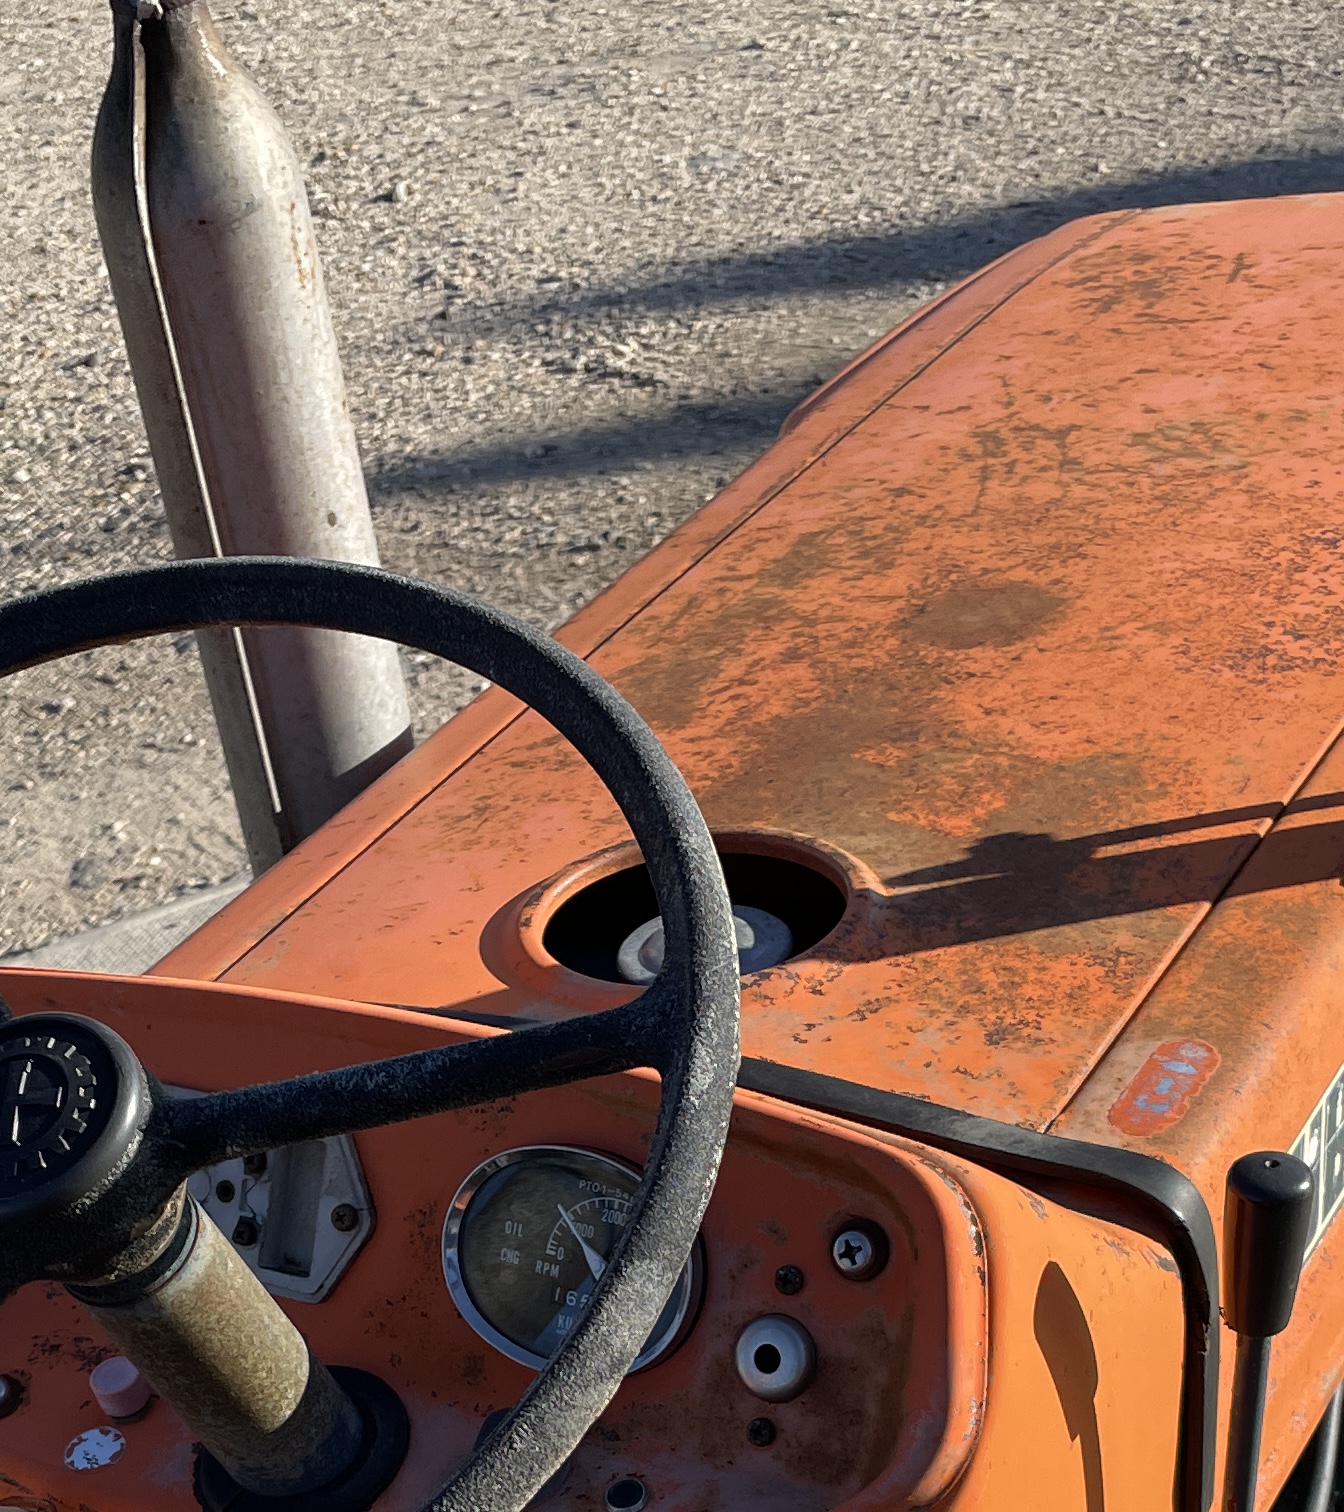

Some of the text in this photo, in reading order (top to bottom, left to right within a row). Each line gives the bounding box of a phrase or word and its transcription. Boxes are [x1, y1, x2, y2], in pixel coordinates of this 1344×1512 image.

[505, 1220, 523, 1238] OIL
[500, 1247, 521, 1265] CHG
[535, 1260, 560, 1279] RPM
